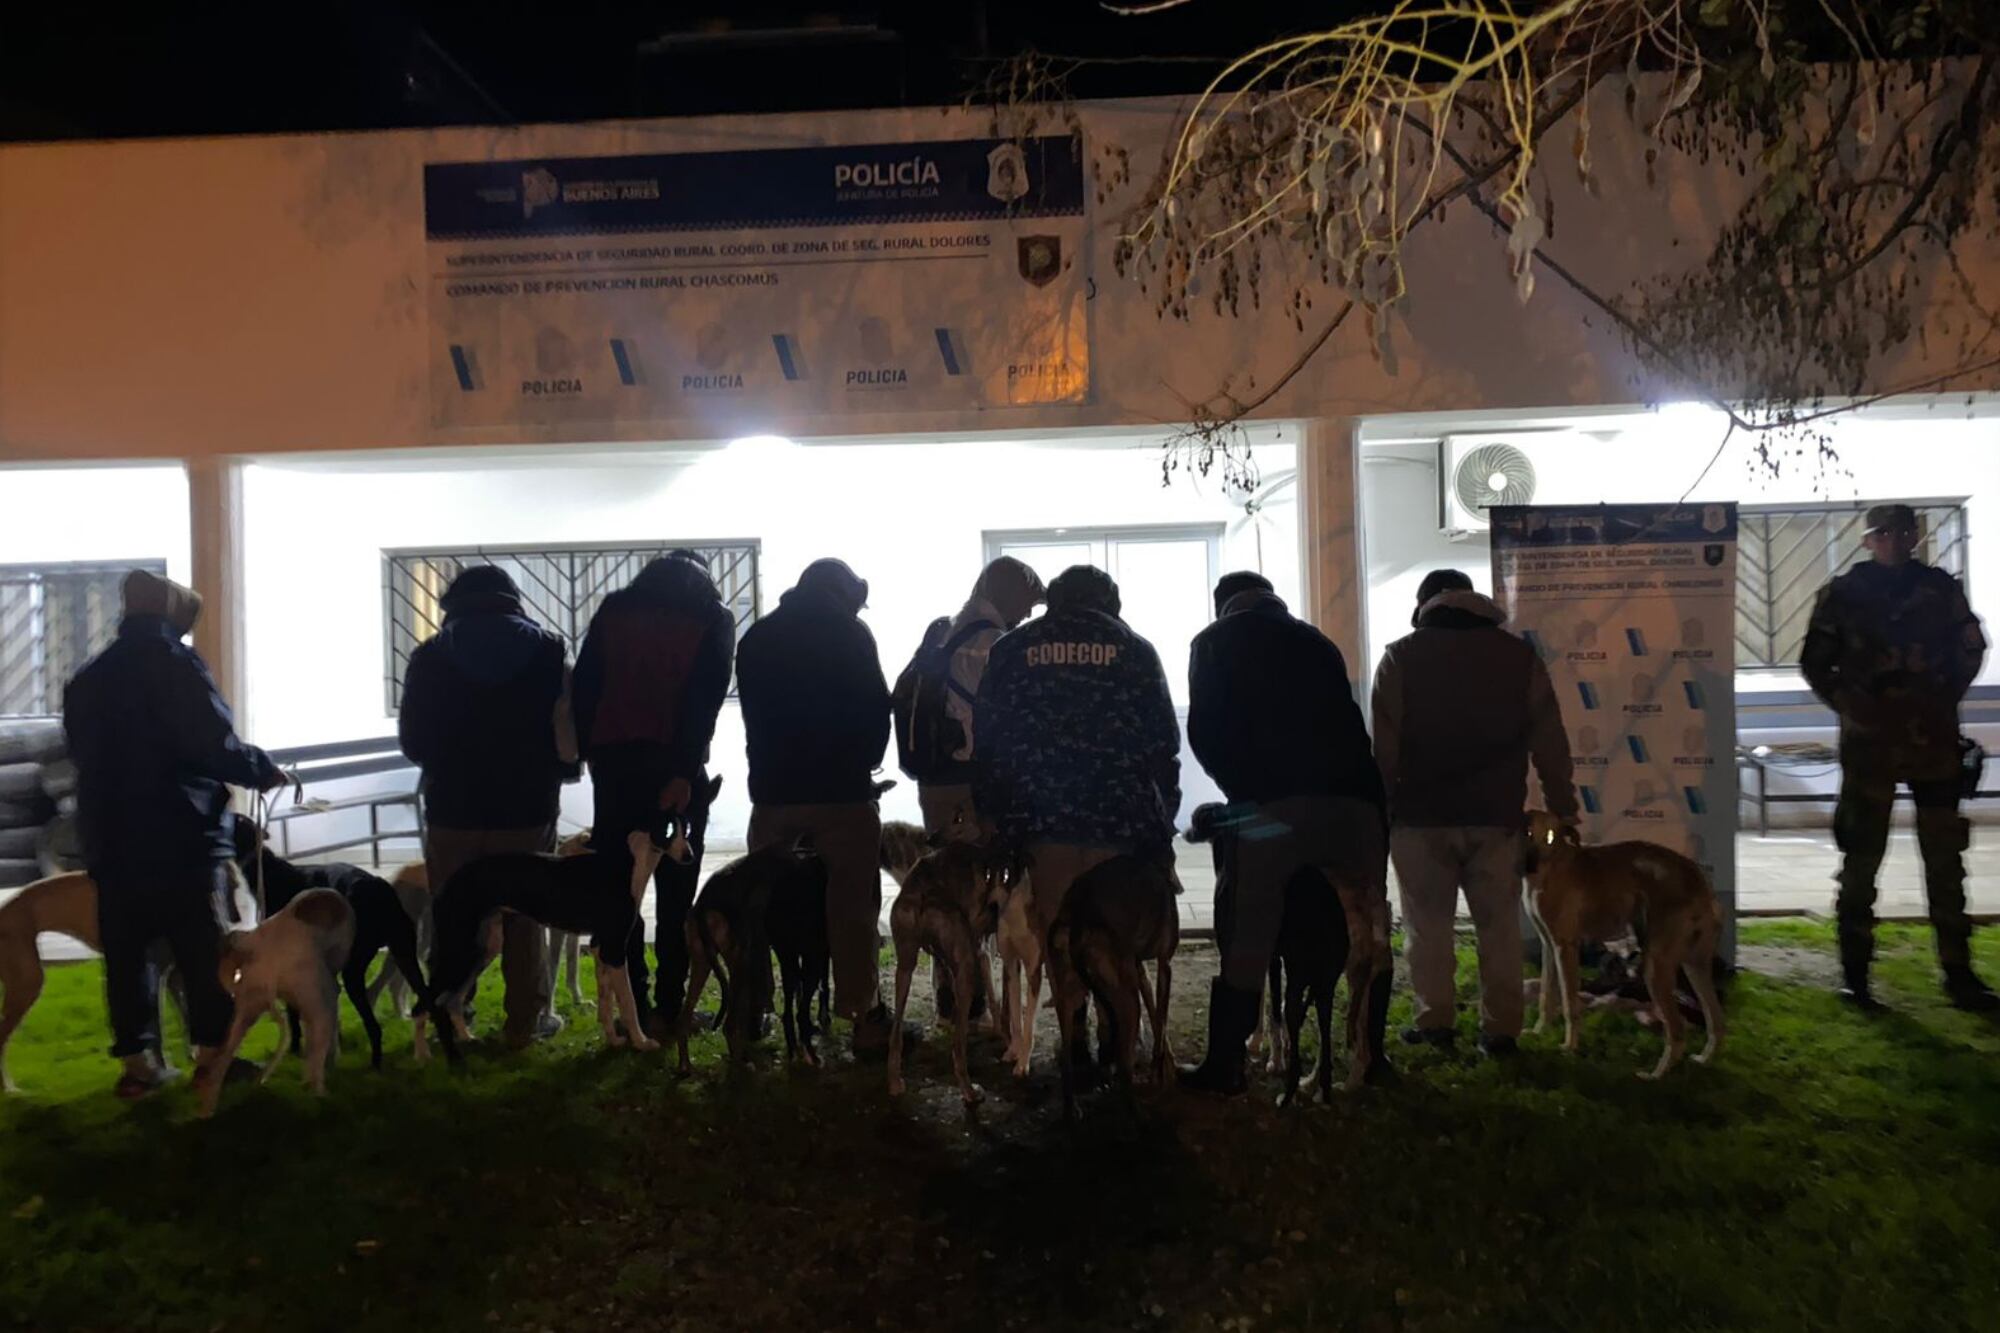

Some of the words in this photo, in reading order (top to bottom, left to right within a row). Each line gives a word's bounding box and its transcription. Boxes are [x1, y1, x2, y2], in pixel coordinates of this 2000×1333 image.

[834, 156, 940, 188] POLICÍA
[576, 249, 595, 262] DE
[597, 246, 671, 261] SEGURIDAD
[674, 245, 716, 257] RURAL
[771, 242, 790, 254] DE
[792, 241, 829, 254] ZONA
[832, 239, 848, 252] DE
[883, 236, 925, 250] RURAL
[930, 234, 991, 249] DOLORES
[446, 282, 519, 298] COMANDO
[523, 281, 540, 295] DE
[639, 275, 687, 290] RURAL
[521, 378, 582, 395] POLICIA
[681, 374, 744, 390] POLICIA
[846, 368, 908, 385] POLICIA
[1027, 641, 1117, 667] CODECOP
